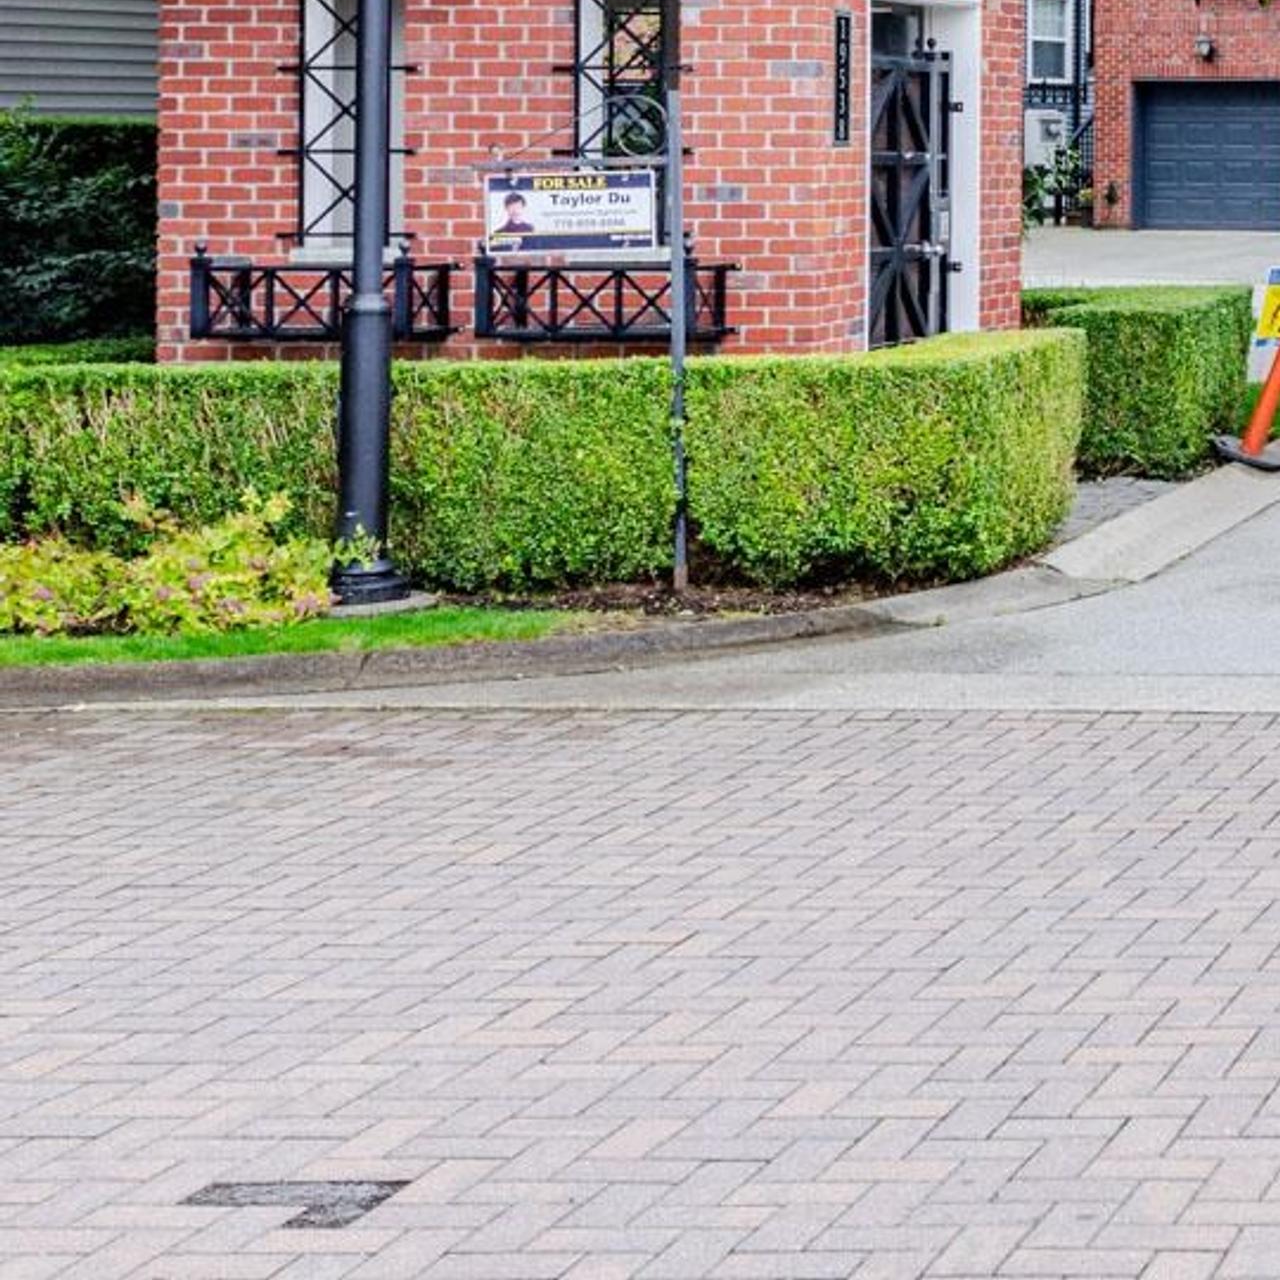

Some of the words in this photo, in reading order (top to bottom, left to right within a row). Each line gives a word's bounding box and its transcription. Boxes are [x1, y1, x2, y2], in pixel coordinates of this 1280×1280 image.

[532, 177, 564, 190] FOR
[566, 176, 606, 189] SALE
[550, 193, 602, 207] Taylor
[608, 191, 632, 204] Du
